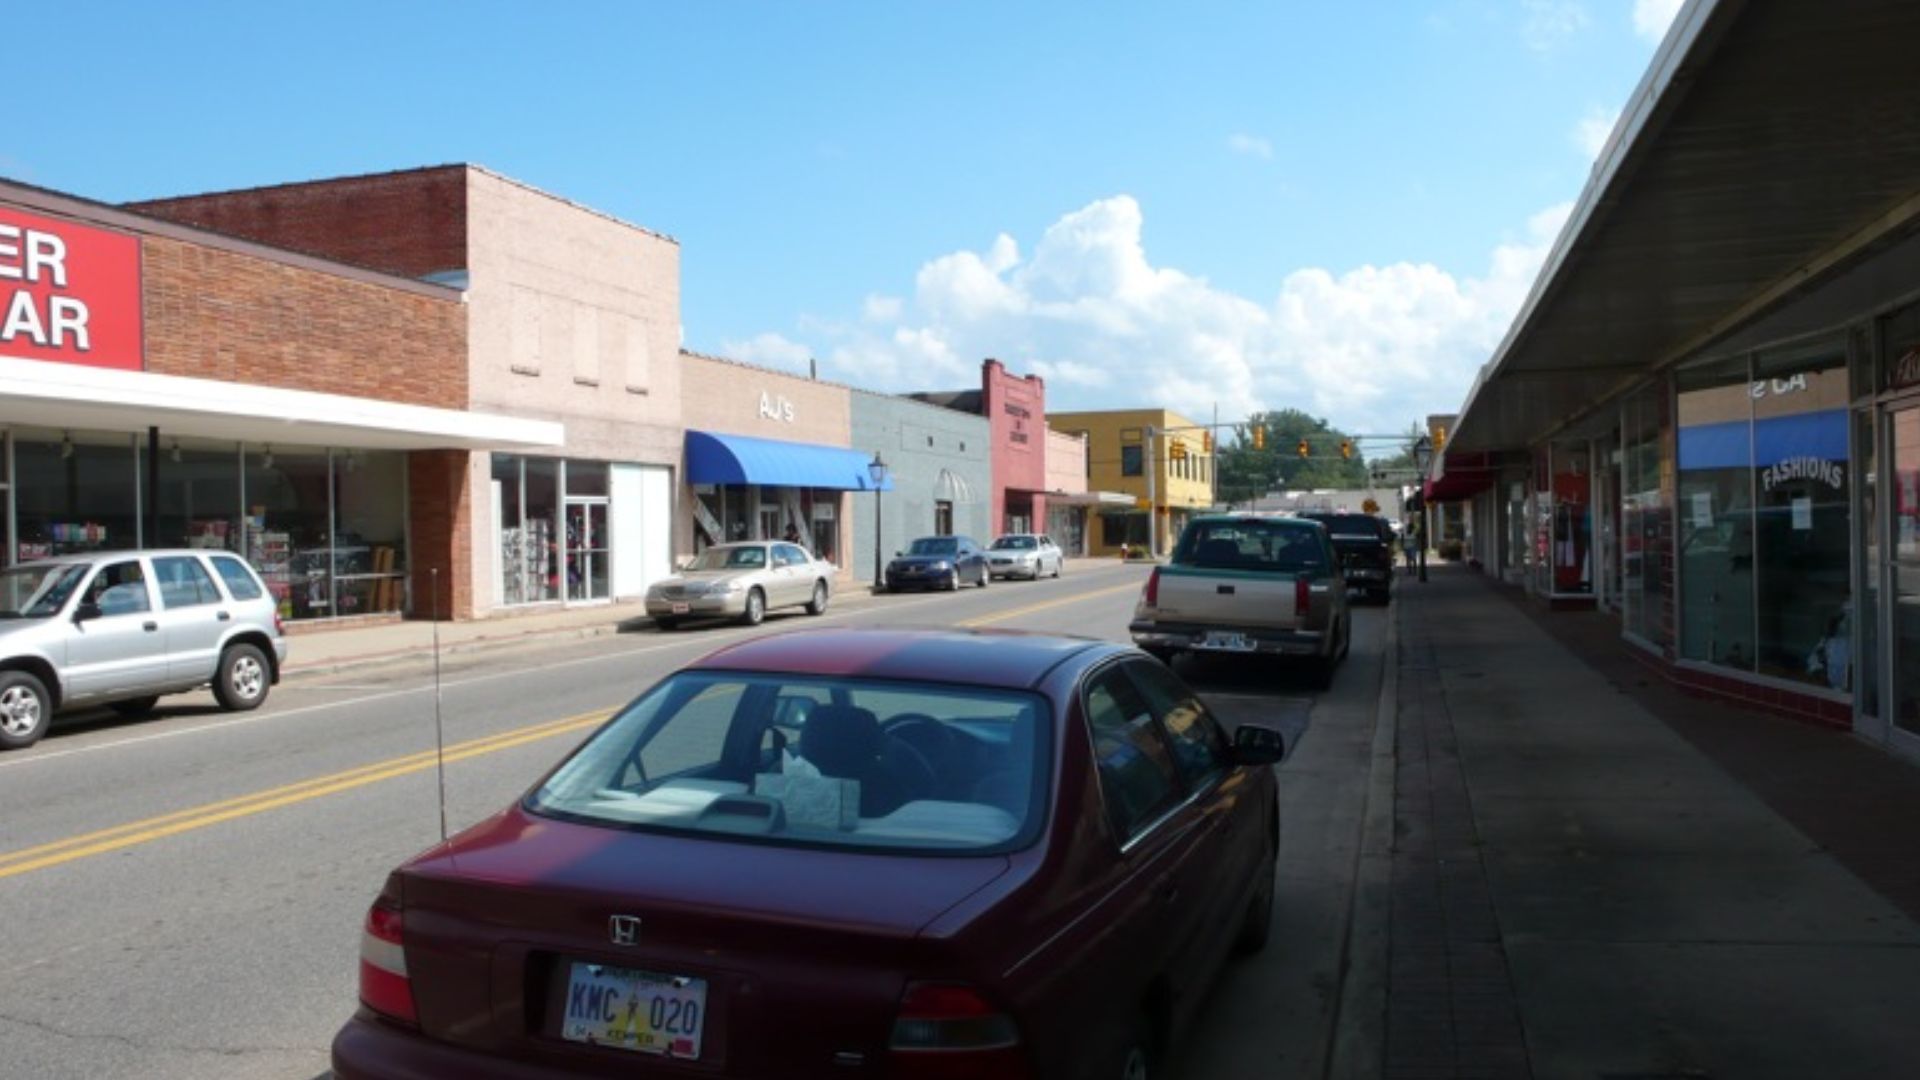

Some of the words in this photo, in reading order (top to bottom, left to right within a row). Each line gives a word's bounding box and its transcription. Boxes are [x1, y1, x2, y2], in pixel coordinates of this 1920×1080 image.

[0, 223, 68, 286] ER
[1, 289, 91, 351] AR
[1762, 456, 1843, 492] FASHIONS
[569, 981, 619, 1024] KMC
[650, 994, 699, 1036] 020
